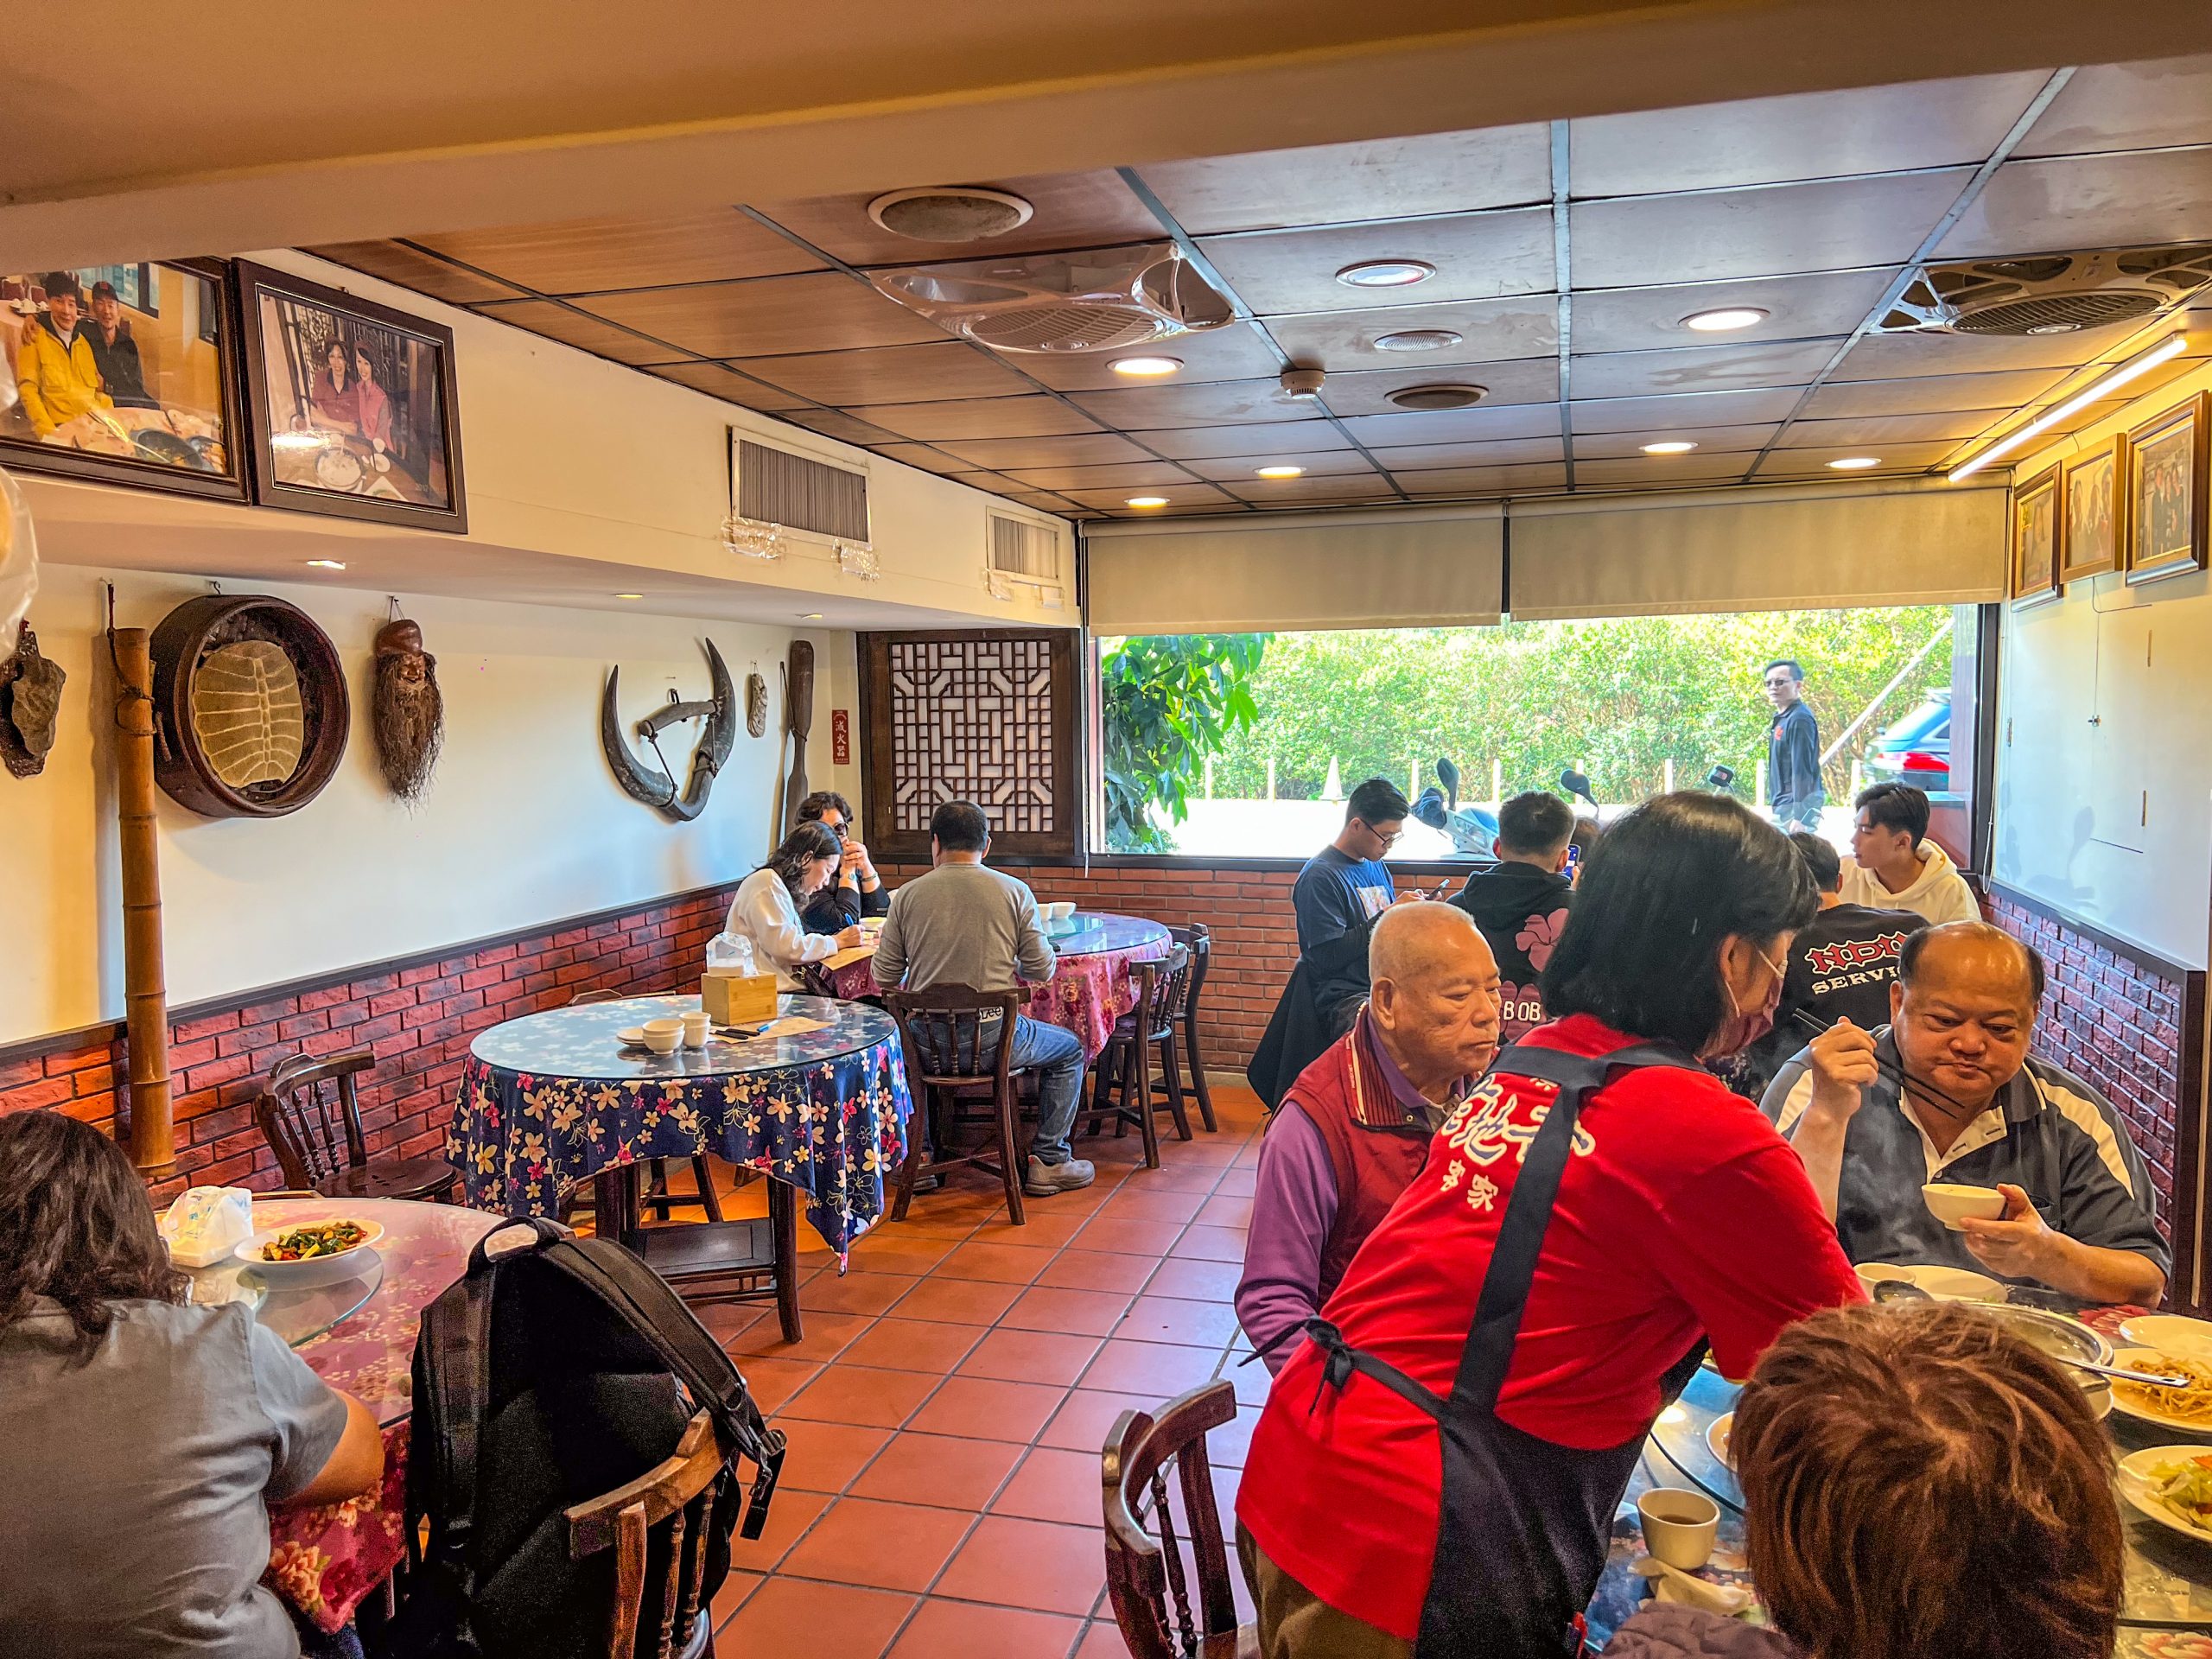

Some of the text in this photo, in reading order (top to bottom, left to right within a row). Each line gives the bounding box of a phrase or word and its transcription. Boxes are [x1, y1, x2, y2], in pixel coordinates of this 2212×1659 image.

[835, 720, 847, 757] 滅火器
[1811, 965, 1900, 995] SERVI
[981, 1007, 1002, 1020] Lee
[1498, 1001, 1541, 1021] BOB
